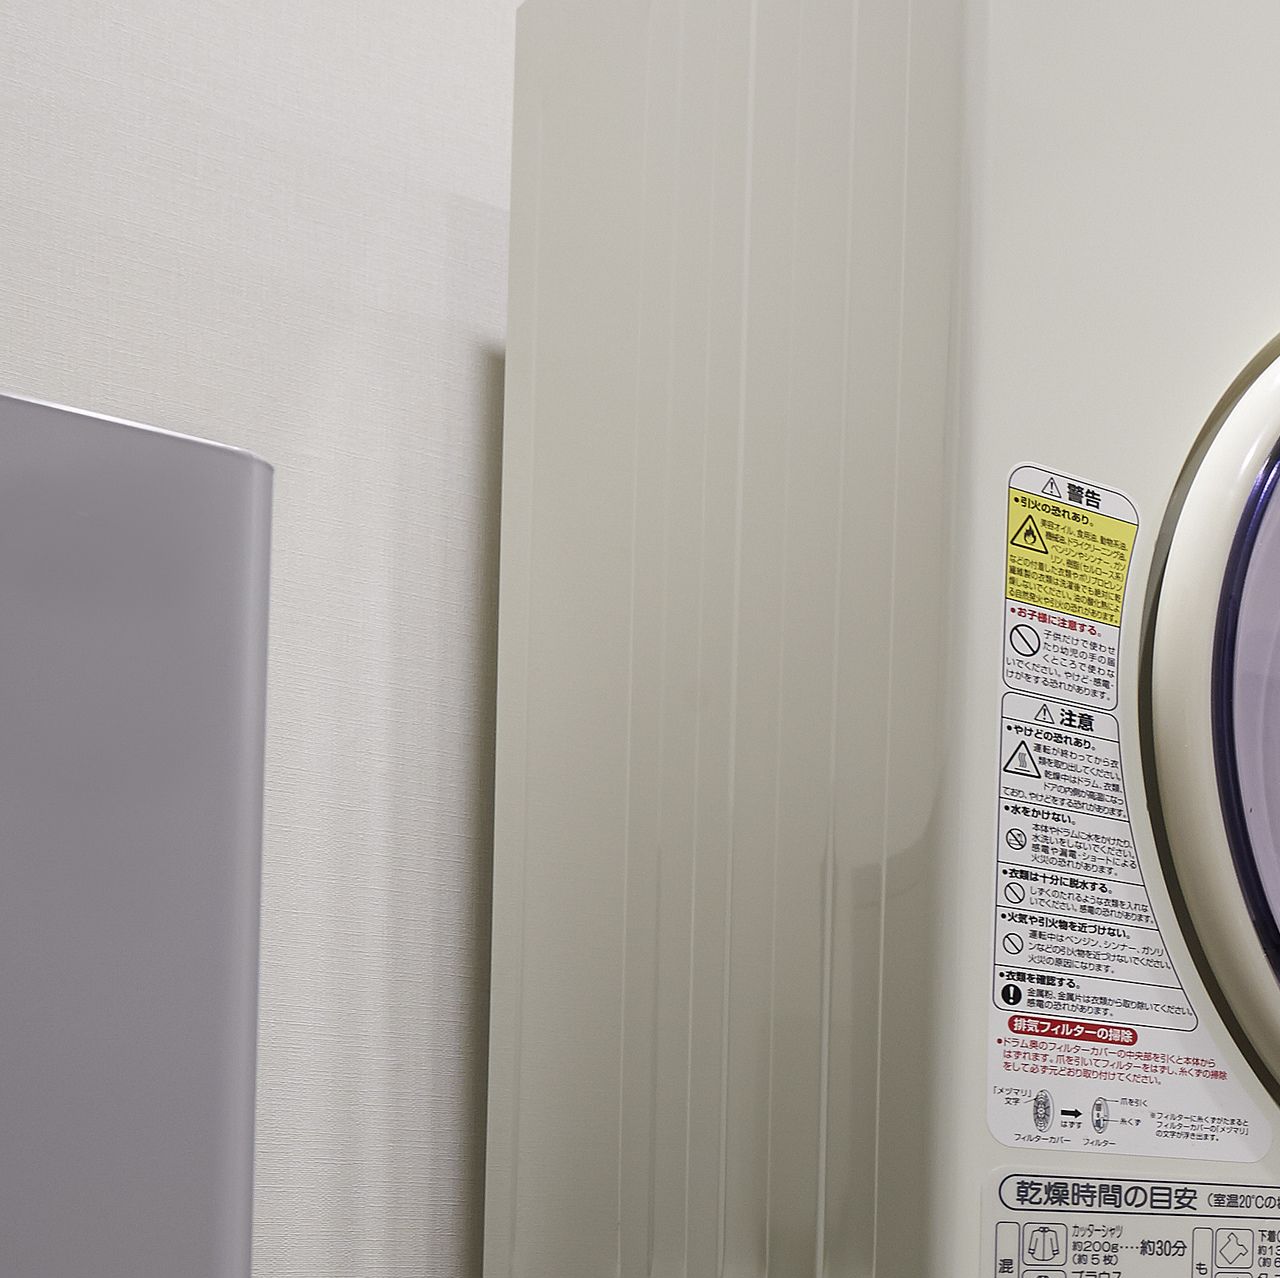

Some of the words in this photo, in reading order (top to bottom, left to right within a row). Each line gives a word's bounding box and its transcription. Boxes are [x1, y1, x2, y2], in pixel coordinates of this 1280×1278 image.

[1067, 483, 1102, 509] 警告
[1020, 496, 1094, 527] 引火の恐れあり。
[1017, 607, 1102, 637] お子様に注意する。
[1043, 630, 1116, 655] 子供だけで使わせ
[1043, 654, 1115, 678] くところで使わな
[1060, 708, 1094, 731] 注意
[1014, 725, 1096, 751] やけどの恐れあり。
[1033, 743, 1119, 769] 運転が終わってから衣
[1010, 804, 1076, 825] 水をかけない。
[1009, 868, 1113, 894] 衣類は十分に脱水する。
[1006, 971, 1080, 989] 衣類を確認する。
[1013, 1017, 1133, 1043] 排気フィルターの掃除
[1017, 1180, 1197, 1211] 乾燥時間の目安
